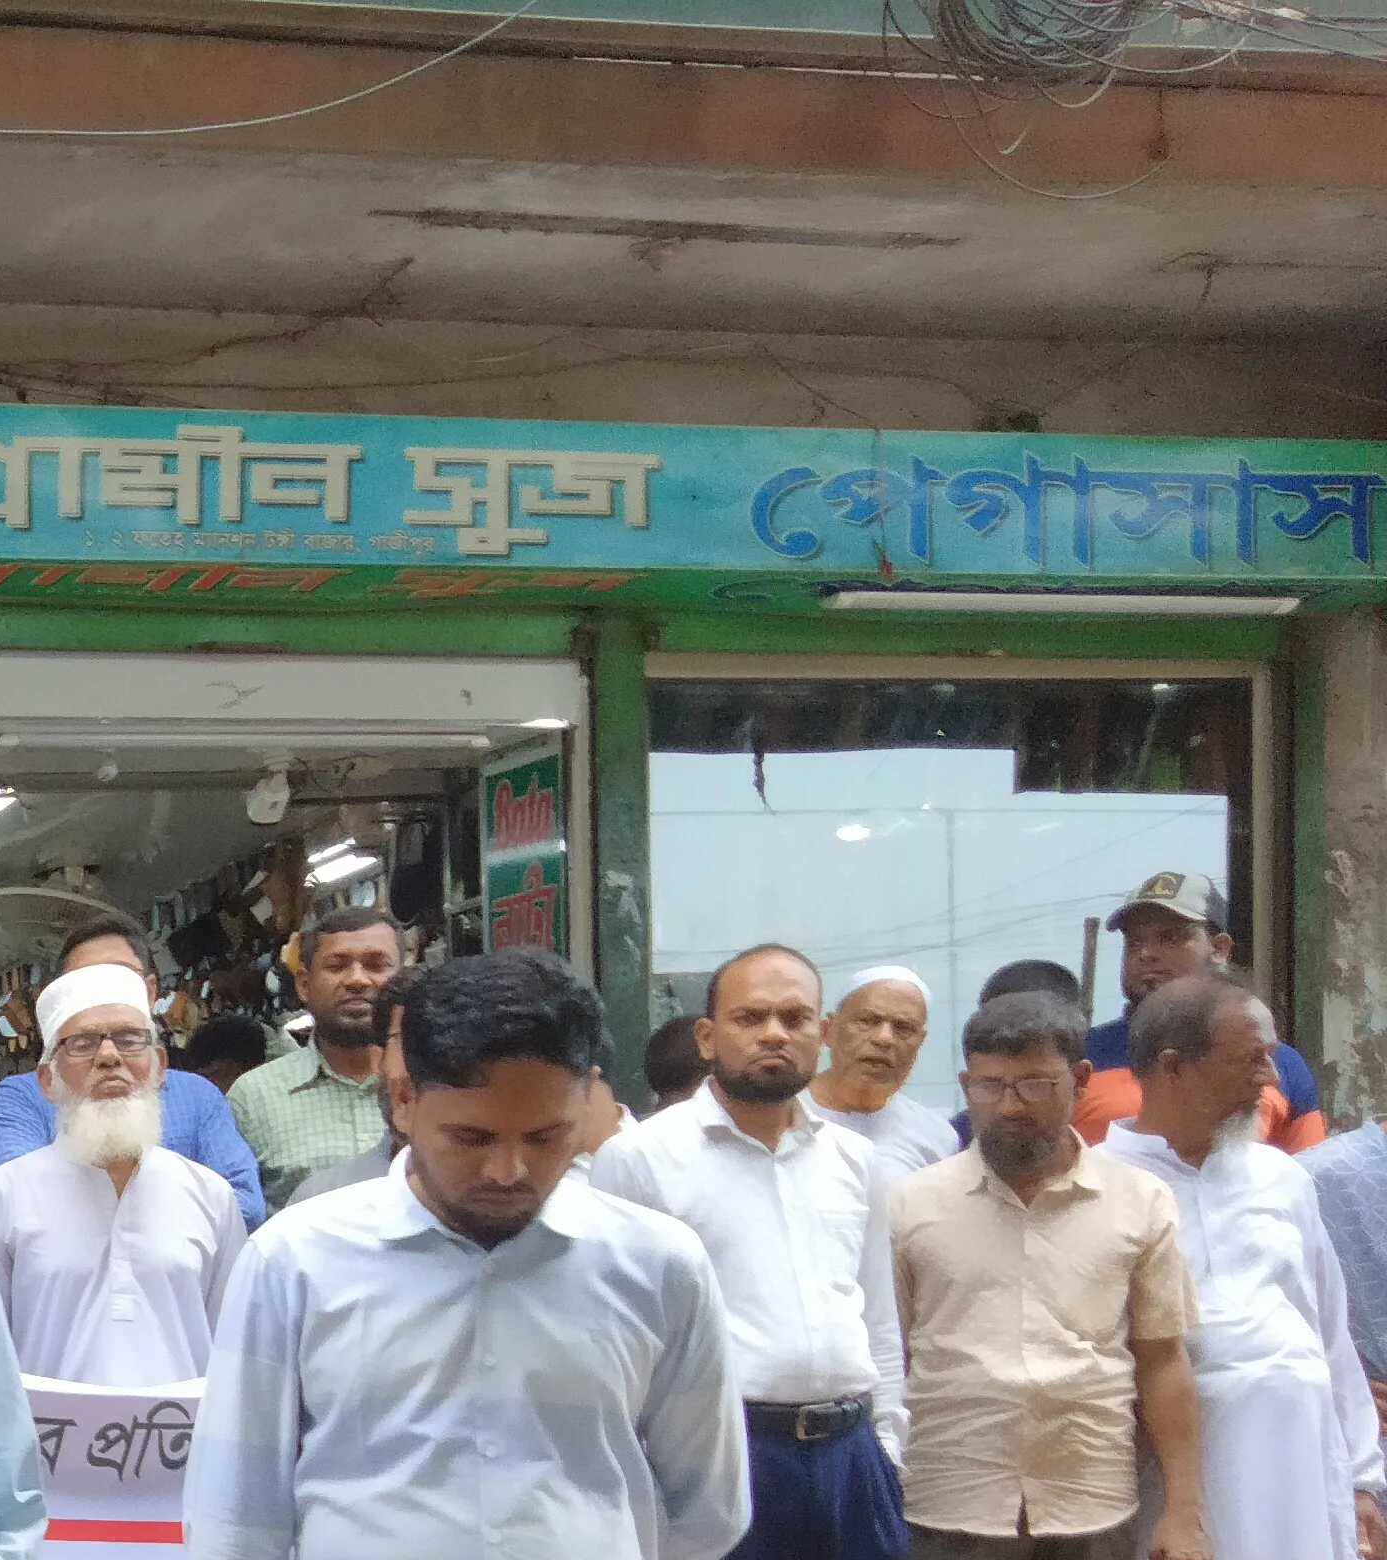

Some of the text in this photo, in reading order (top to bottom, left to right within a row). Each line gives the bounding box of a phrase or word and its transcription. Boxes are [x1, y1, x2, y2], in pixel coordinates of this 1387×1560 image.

[404, 444, 663, 556] সুজ
[751, 450, 1385, 567] পেগাসাস
[86, 1400, 195, 1483] প্রতি
